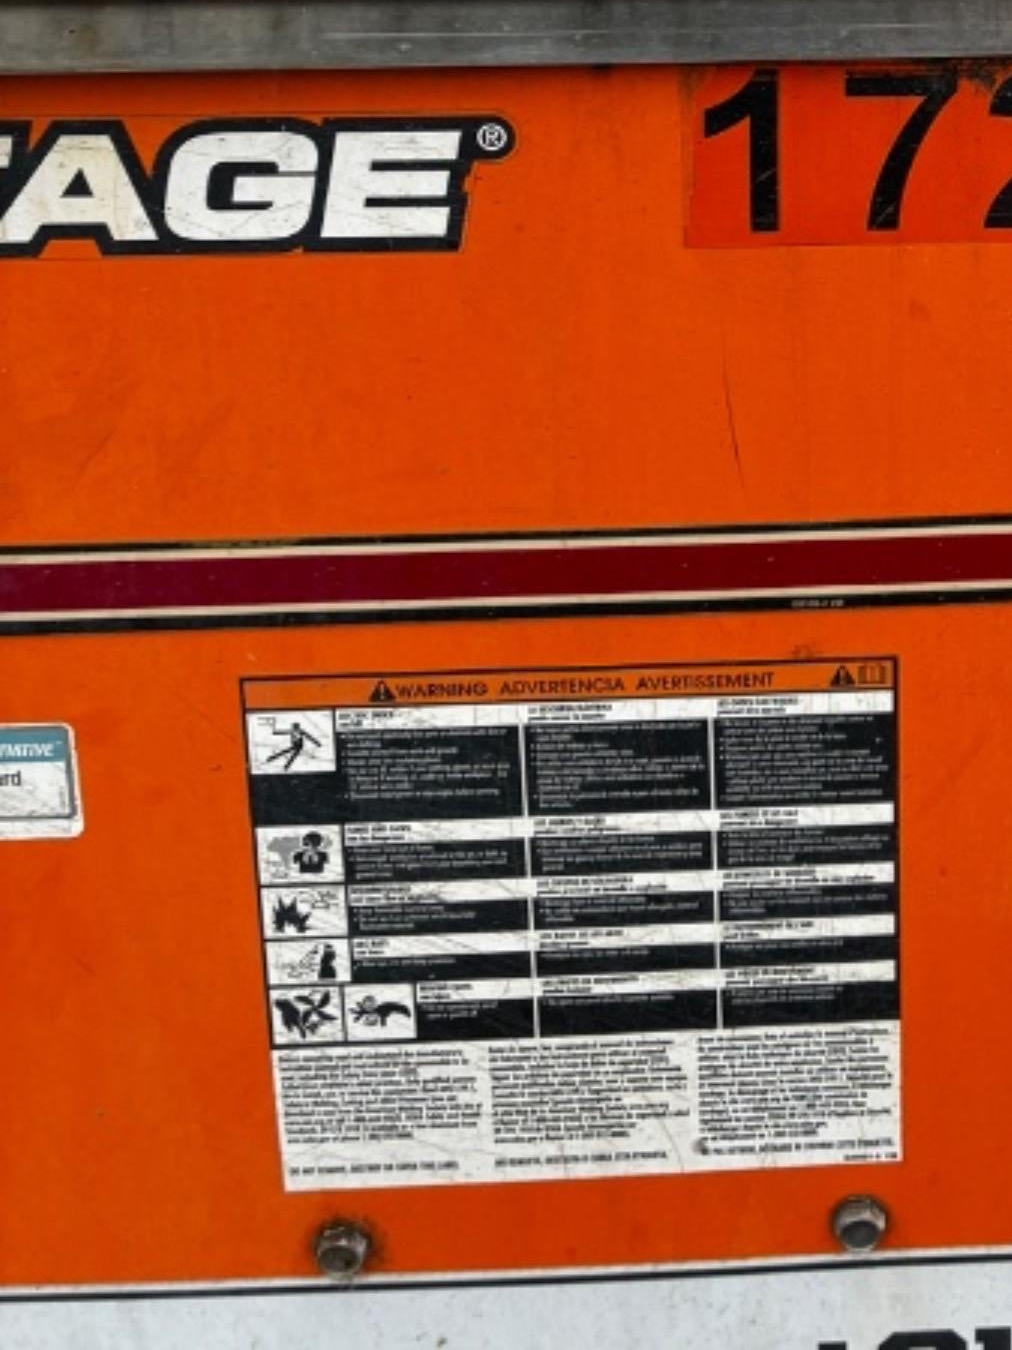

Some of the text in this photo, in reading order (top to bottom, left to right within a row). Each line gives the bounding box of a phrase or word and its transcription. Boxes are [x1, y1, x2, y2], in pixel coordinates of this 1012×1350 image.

[397, 672, 775, 698] WARNING ADVERTENCIA AVERTISSEMENT
